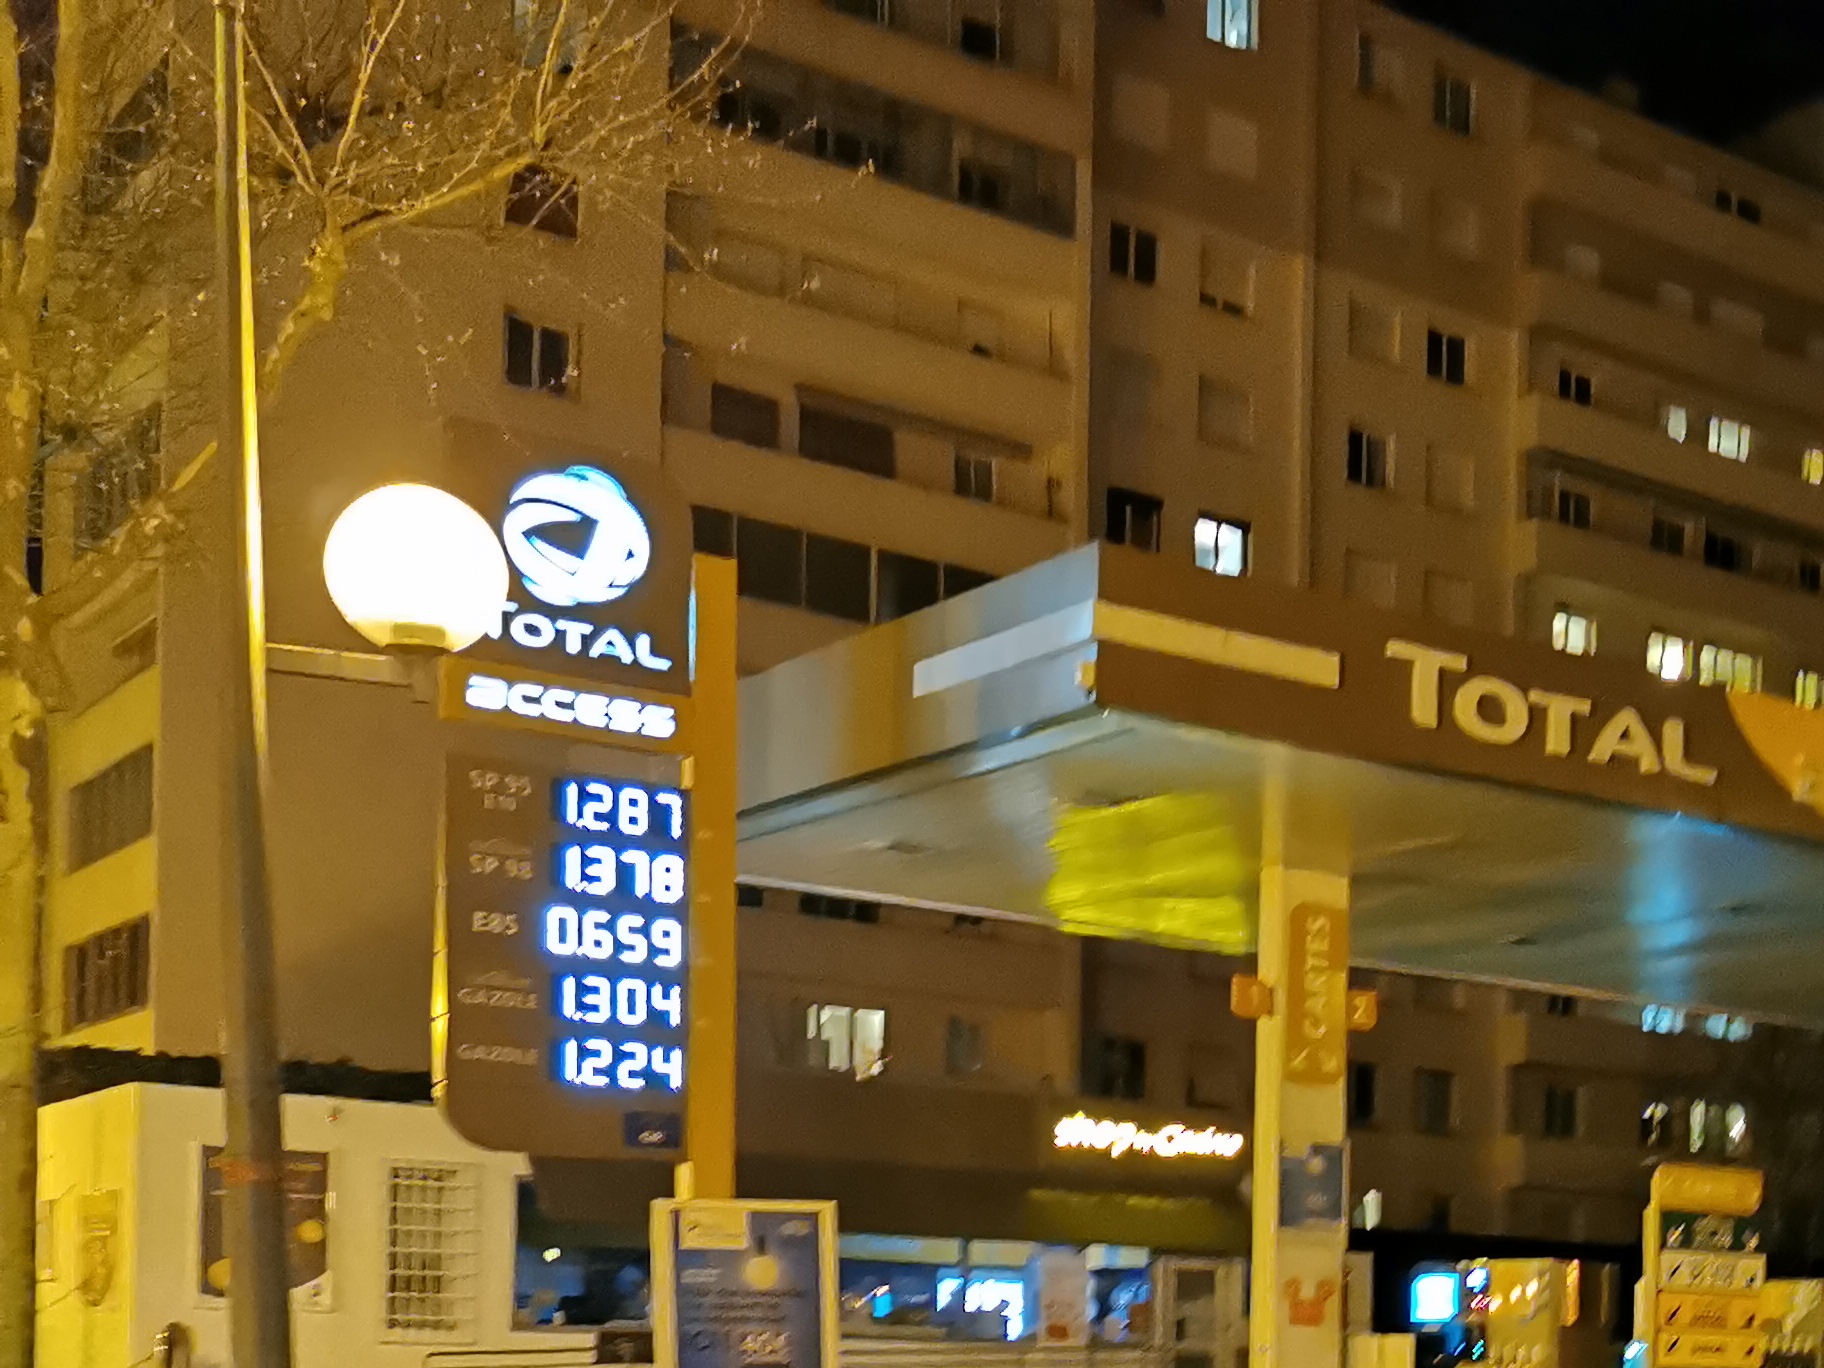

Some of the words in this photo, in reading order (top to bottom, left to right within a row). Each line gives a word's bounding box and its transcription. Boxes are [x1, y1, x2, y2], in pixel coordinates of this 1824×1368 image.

[484, 600, 673, 672] TOTAL
[465, 673, 677, 740] access
[1385, 637, 1718, 787] TOTAL
